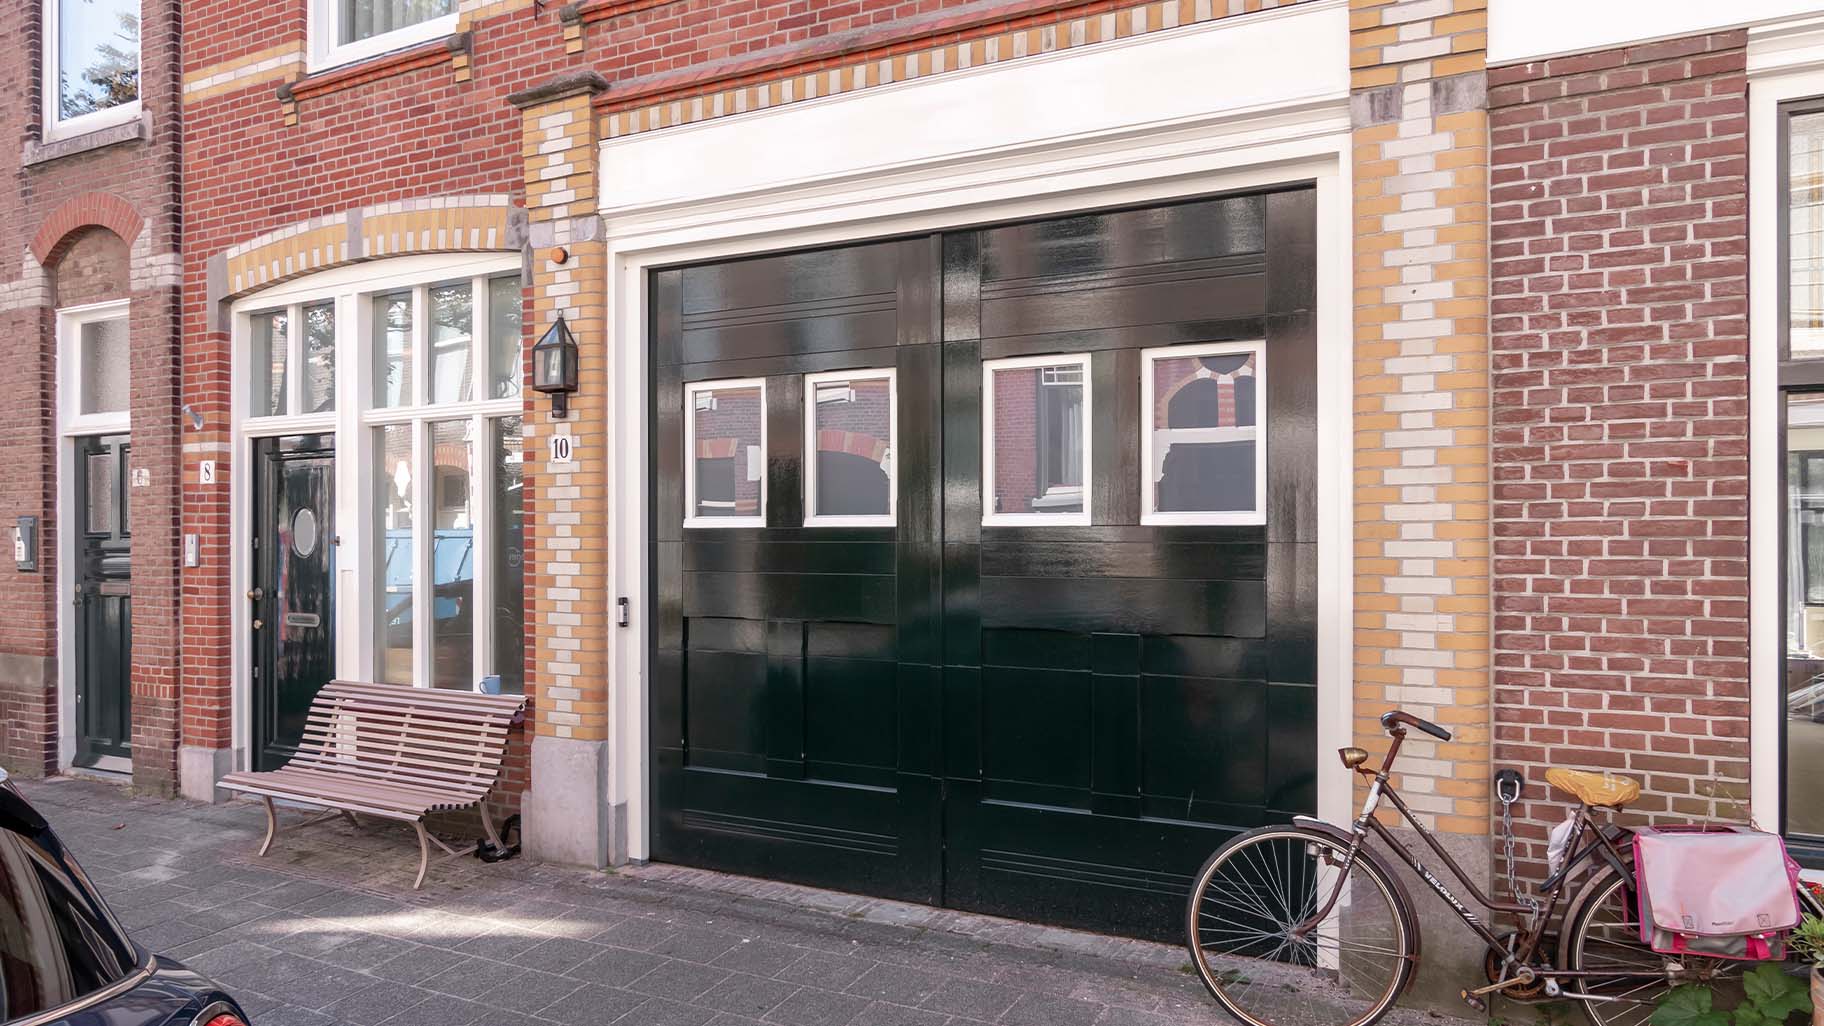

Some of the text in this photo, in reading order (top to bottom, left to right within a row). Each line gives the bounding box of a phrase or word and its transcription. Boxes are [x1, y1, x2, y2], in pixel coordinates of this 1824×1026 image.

[553, 438, 569, 459] 10
[204, 462, 211, 481] 8
[1425, 871, 1464, 911] VELOLUX
